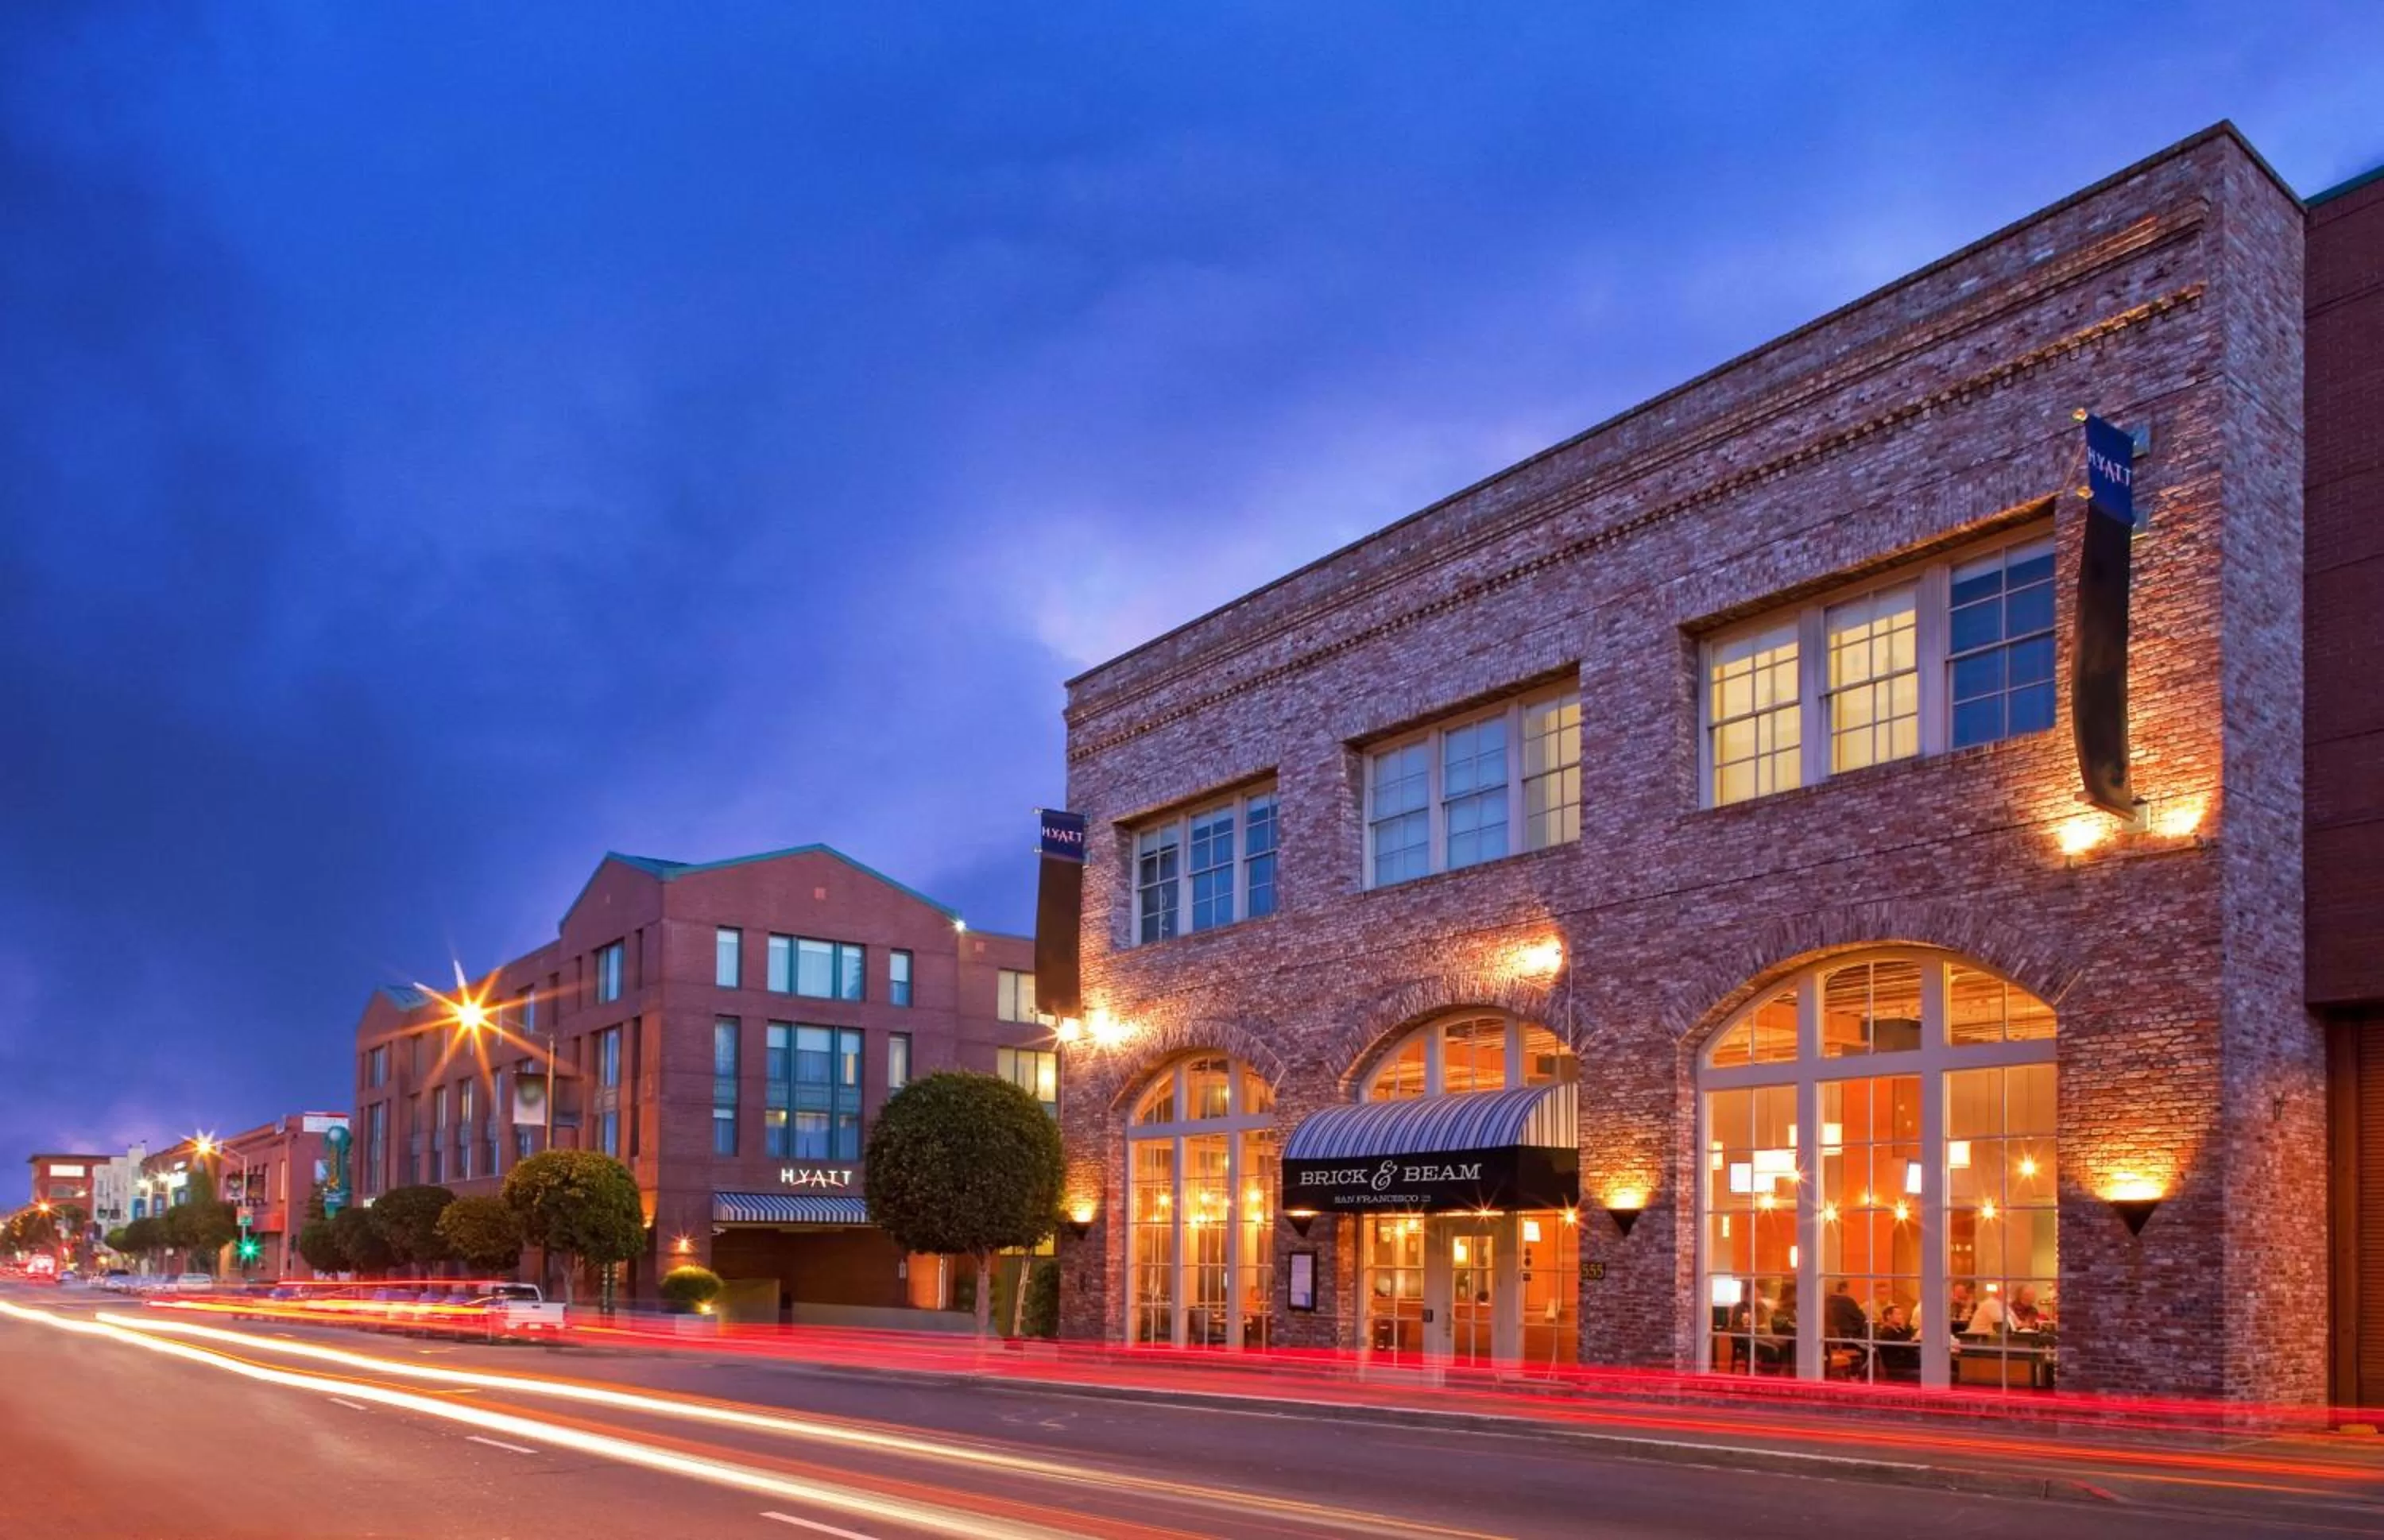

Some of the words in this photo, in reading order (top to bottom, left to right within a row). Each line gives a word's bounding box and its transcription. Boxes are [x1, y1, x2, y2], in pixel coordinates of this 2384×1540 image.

[2087, 446, 2131, 486] HYATT
[1042, 826, 1082, 843] HYATT
[781, 1167, 853, 1188] HYATT
[1299, 1168, 1368, 1186] BRICK
[1371, 1159, 1399, 1191] &
[1403, 1163, 1482, 1182] BEAM
[1334, 1195, 1355, 1204] SAN
[1356, 1194, 1418, 1204] FRANCISCO
[1581, 1263, 1604, 1279] 555
